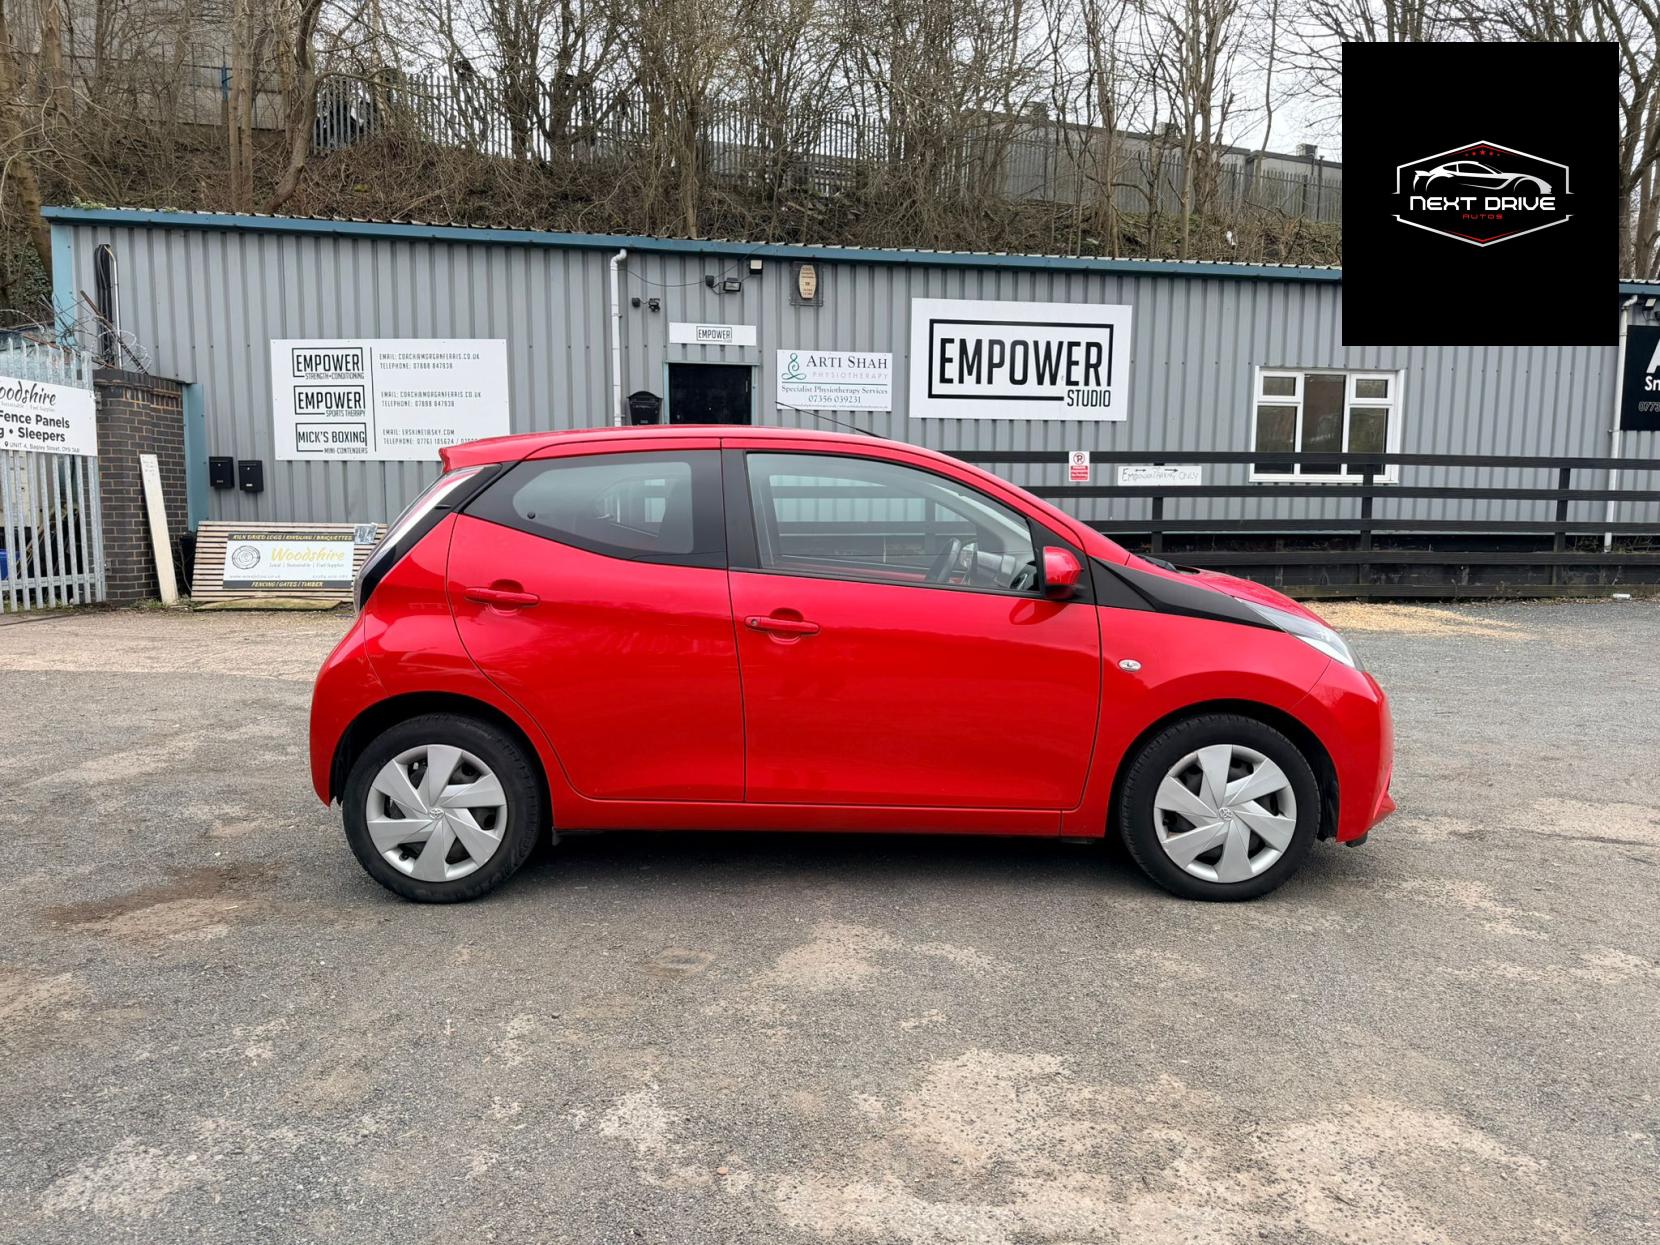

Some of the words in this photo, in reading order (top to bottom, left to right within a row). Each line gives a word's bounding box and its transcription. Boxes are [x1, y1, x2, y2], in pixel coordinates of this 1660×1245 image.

[698, 329, 731, 340] EMPOWER
[296, 354, 360, 372] EMPOWER
[806, 355, 841, 368] ARTI
[848, 356, 888, 369] SHAH
[939, 337, 1103, 387] EMPOWER
[812, 371, 888, 380] PHYSIOTHERAPY
[781, 385, 812, 394] Specialist
[814, 386, 860, 395] Physiotherapy
[862, 387, 889, 395] Services
[298, 391, 362, 410] EMPOWER
[808, 395, 832, 403] 07356
[1067, 389, 1112, 408] STUDIO
[325, 409, 344, 417] SPORTS
[345, 409, 366, 417] THERAPY
[35, 414, 70, 429] Panels
[18, 427, 66, 443] Sleepers
[298, 431, 329, 443] MICK'S
[331, 431, 365, 443] BOXING
[271, 546, 345, 562] Woodshire
